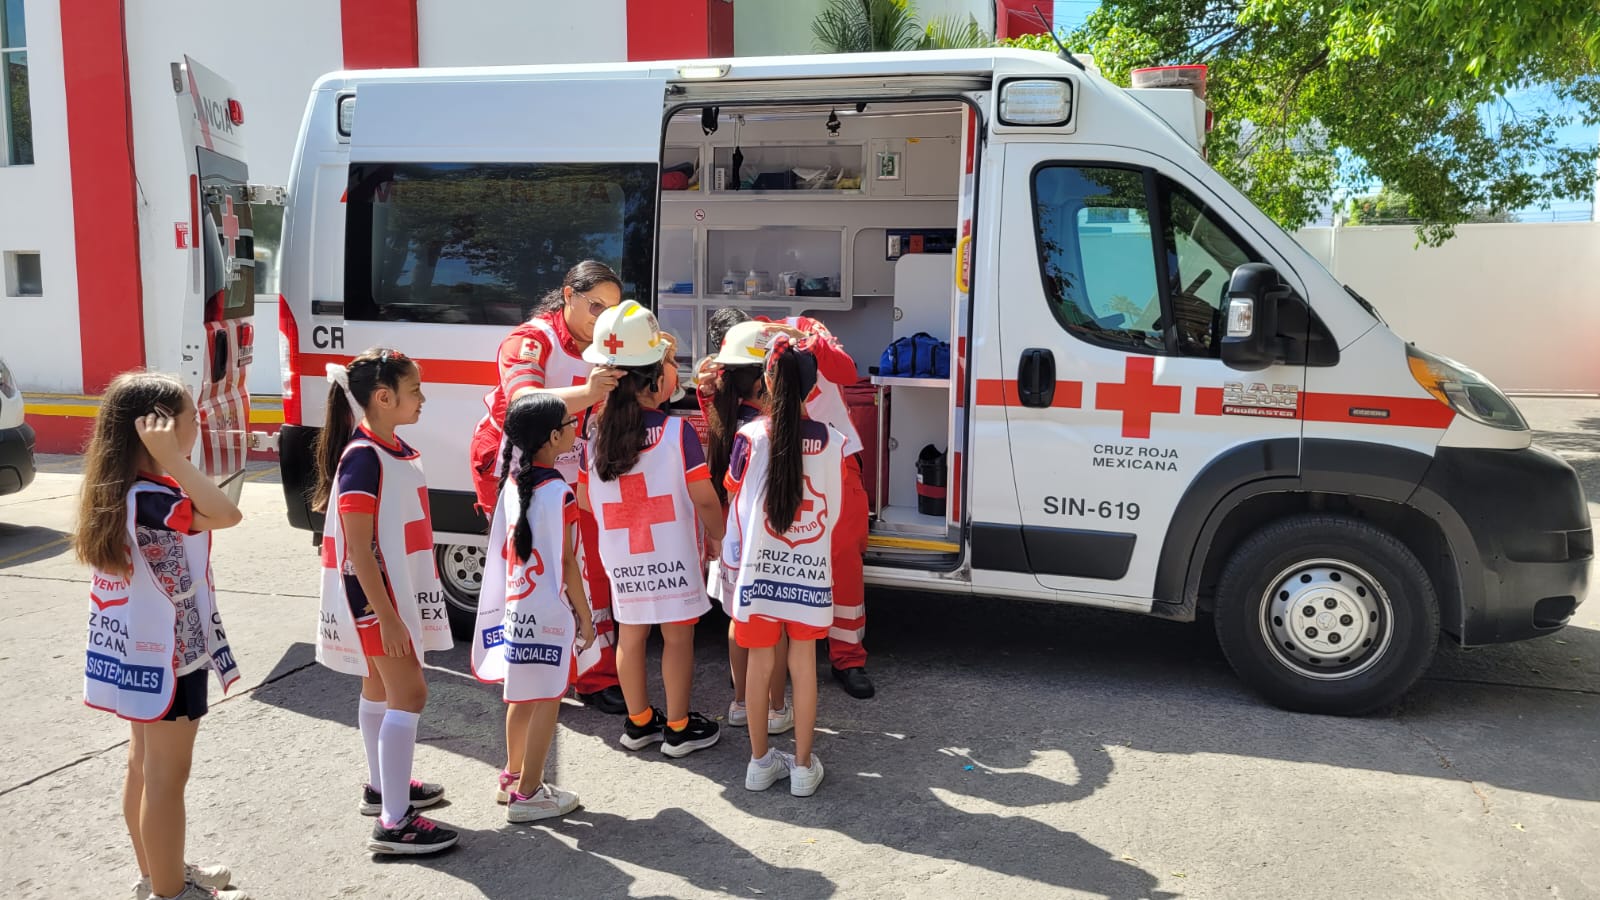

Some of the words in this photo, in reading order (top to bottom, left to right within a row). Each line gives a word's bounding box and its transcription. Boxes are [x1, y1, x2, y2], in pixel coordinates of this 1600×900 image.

[1094, 444, 1134, 456] CRUZ
[1138, 447, 1179, 459] ROJA
[1092, 457, 1178, 472] MEXICANA
[1043, 496, 1140, 521] SIN-619
[792, 554, 827, 567] ROJA
[613, 565, 645, 579] CRUZ
[647, 560, 685, 575] ROJA
[617, 576, 688, 593] MEXICANA
